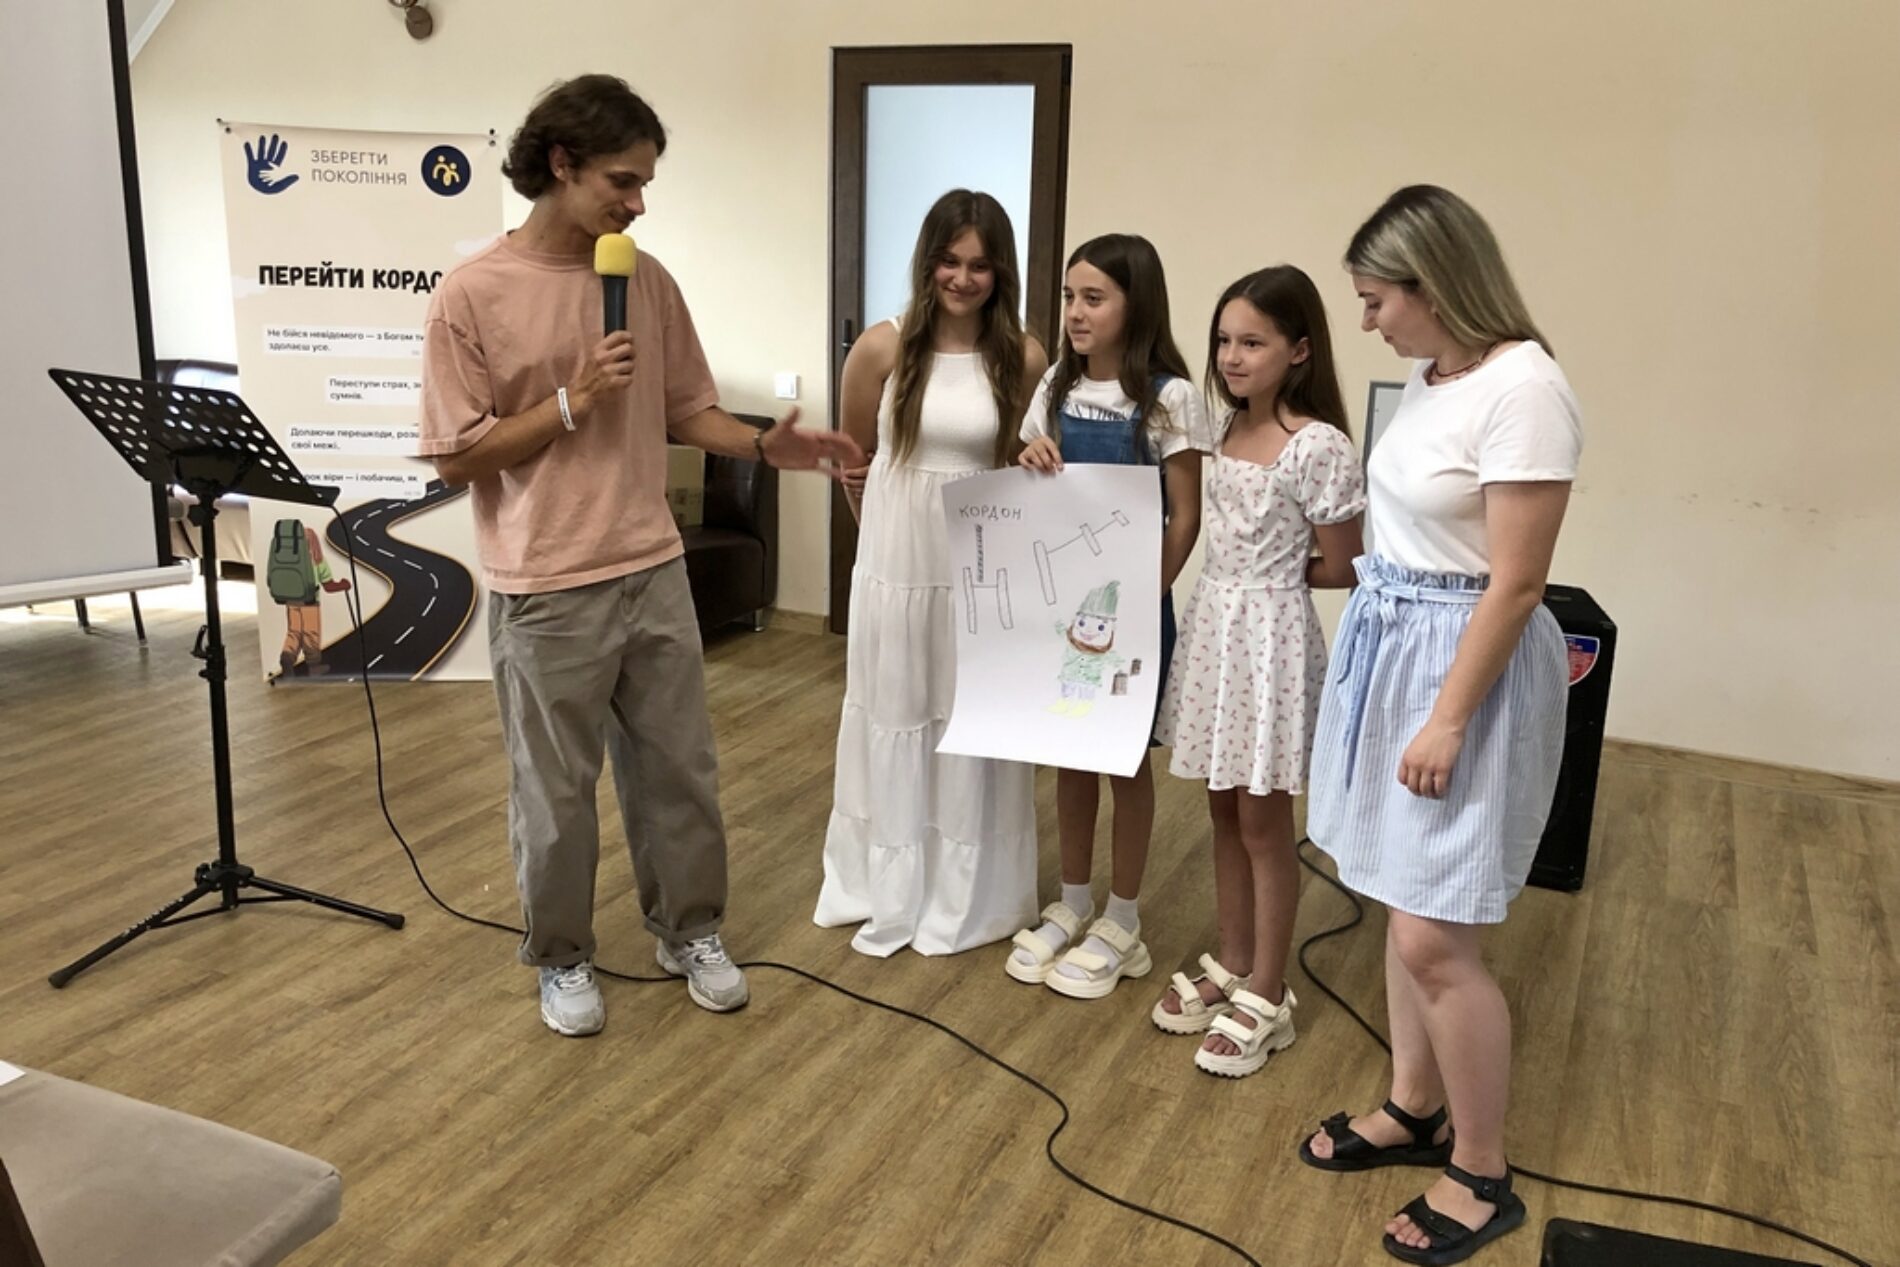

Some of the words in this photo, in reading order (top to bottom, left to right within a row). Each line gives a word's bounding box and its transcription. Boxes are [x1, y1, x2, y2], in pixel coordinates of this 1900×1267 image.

[311, 149, 388, 165] ЗБЕРЕГТИ
[311, 168, 407, 185] ПОКОЛІННЯ
[259, 261, 364, 288] ПЕРЕЙТИ
[373, 268, 443, 294] КОРДО
[267, 329, 280, 338] Не
[310, 330, 364, 341] невідомого
[384, 332, 413, 341] Богом
[329, 378, 380, 390] Переступи
[290, 428, 335, 438] Долаючи
[958, 505, 1022, 521] КОРДОН
